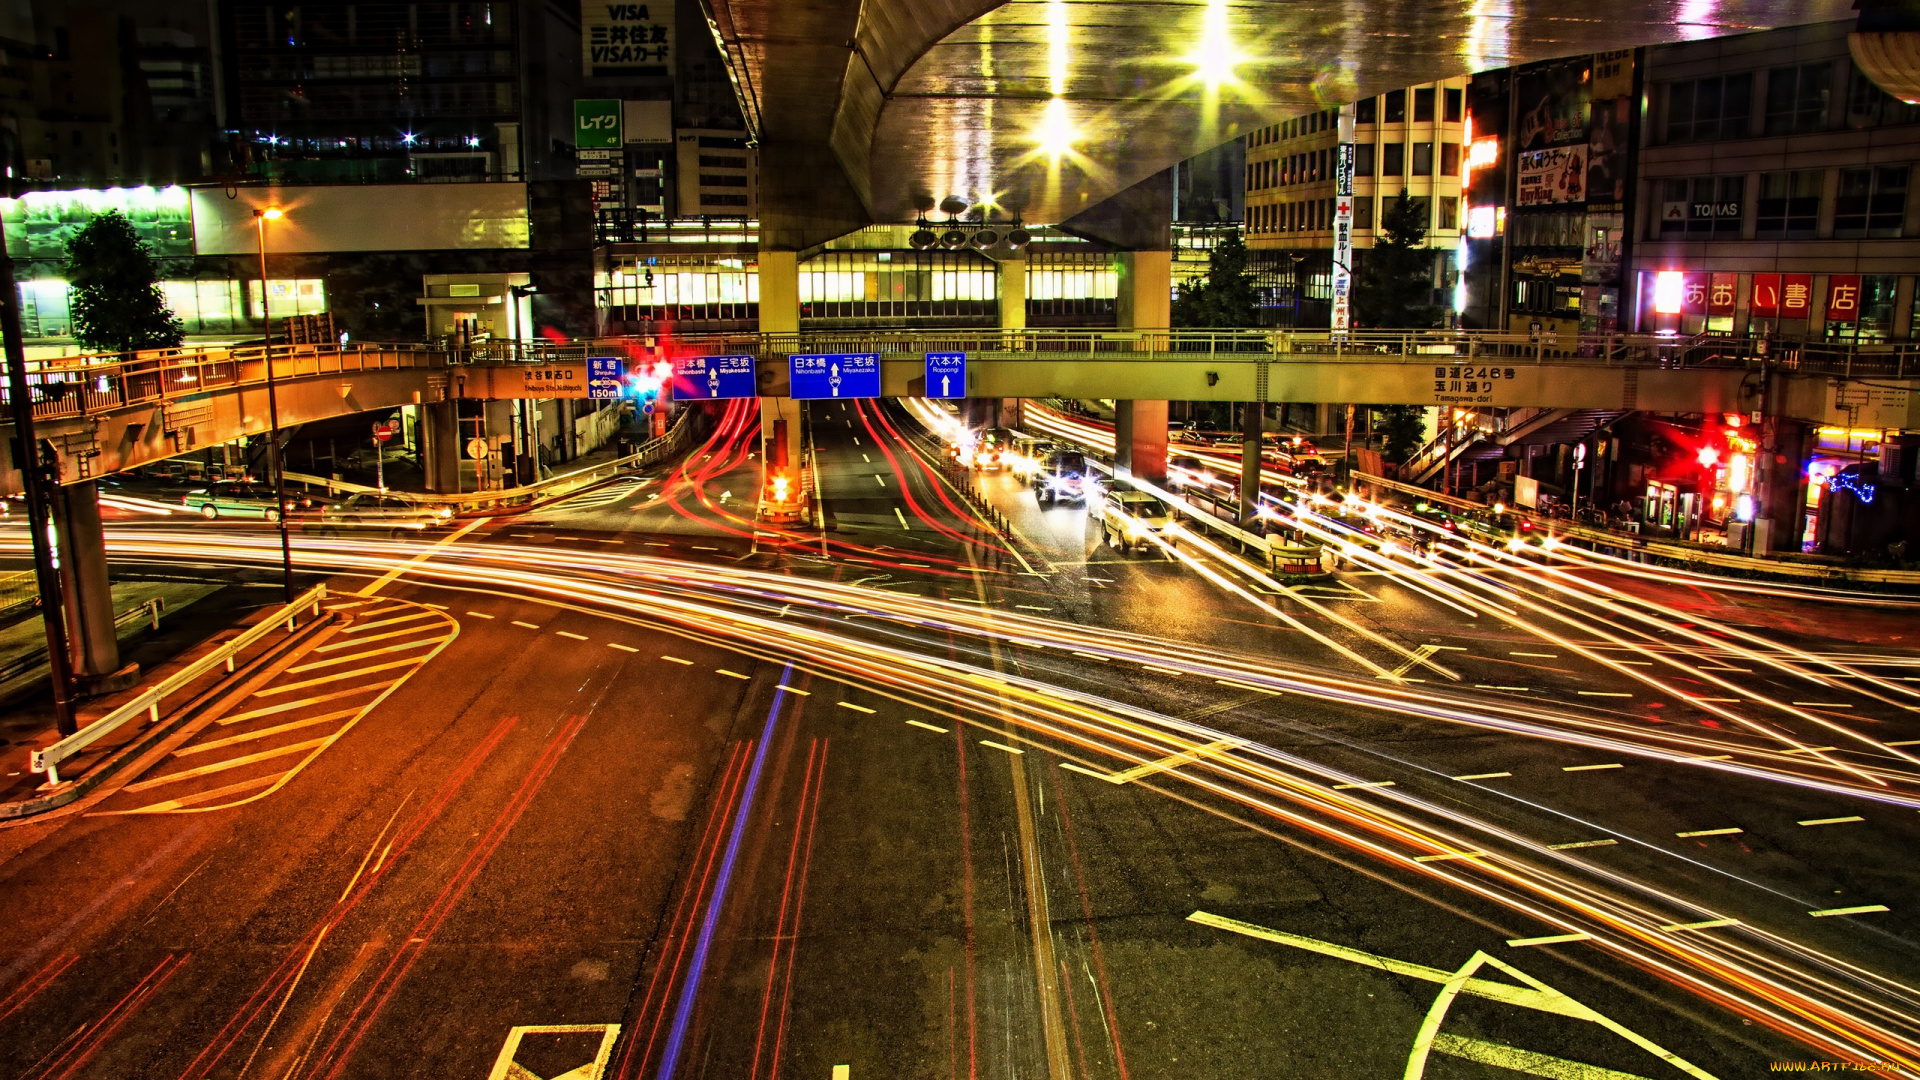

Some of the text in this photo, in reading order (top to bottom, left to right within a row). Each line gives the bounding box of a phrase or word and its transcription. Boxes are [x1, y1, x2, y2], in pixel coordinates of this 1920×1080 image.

[606, 4, 650, 20] VISA
[591, 25, 667, 44] 三井住友
[591, 46, 669, 62] VISAカード
[580, 115, 617, 130] レイク
[606, 136, 617, 145] 4F
[1694, 203, 1738, 216] TOMAS
[1686, 283, 1857, 310] あおい書店
[592, 360, 617, 370] 新宿
[677, 357, 750, 369] 日本橋 三宅坂
[795, 356, 875, 368] 日本橋 三宅坂
[929, 356, 962, 367] 六本木
[524, 370, 573, 380] 渋谷駅西口
[932, 367, 959, 375] Roppongi
[1435, 367, 1515, 379] 国道246号
[1434, 381, 1492, 393] 玉川通り
[591, 389, 617, 398] 150m
[1434, 394, 1493, 404] Tamagawa-dori
